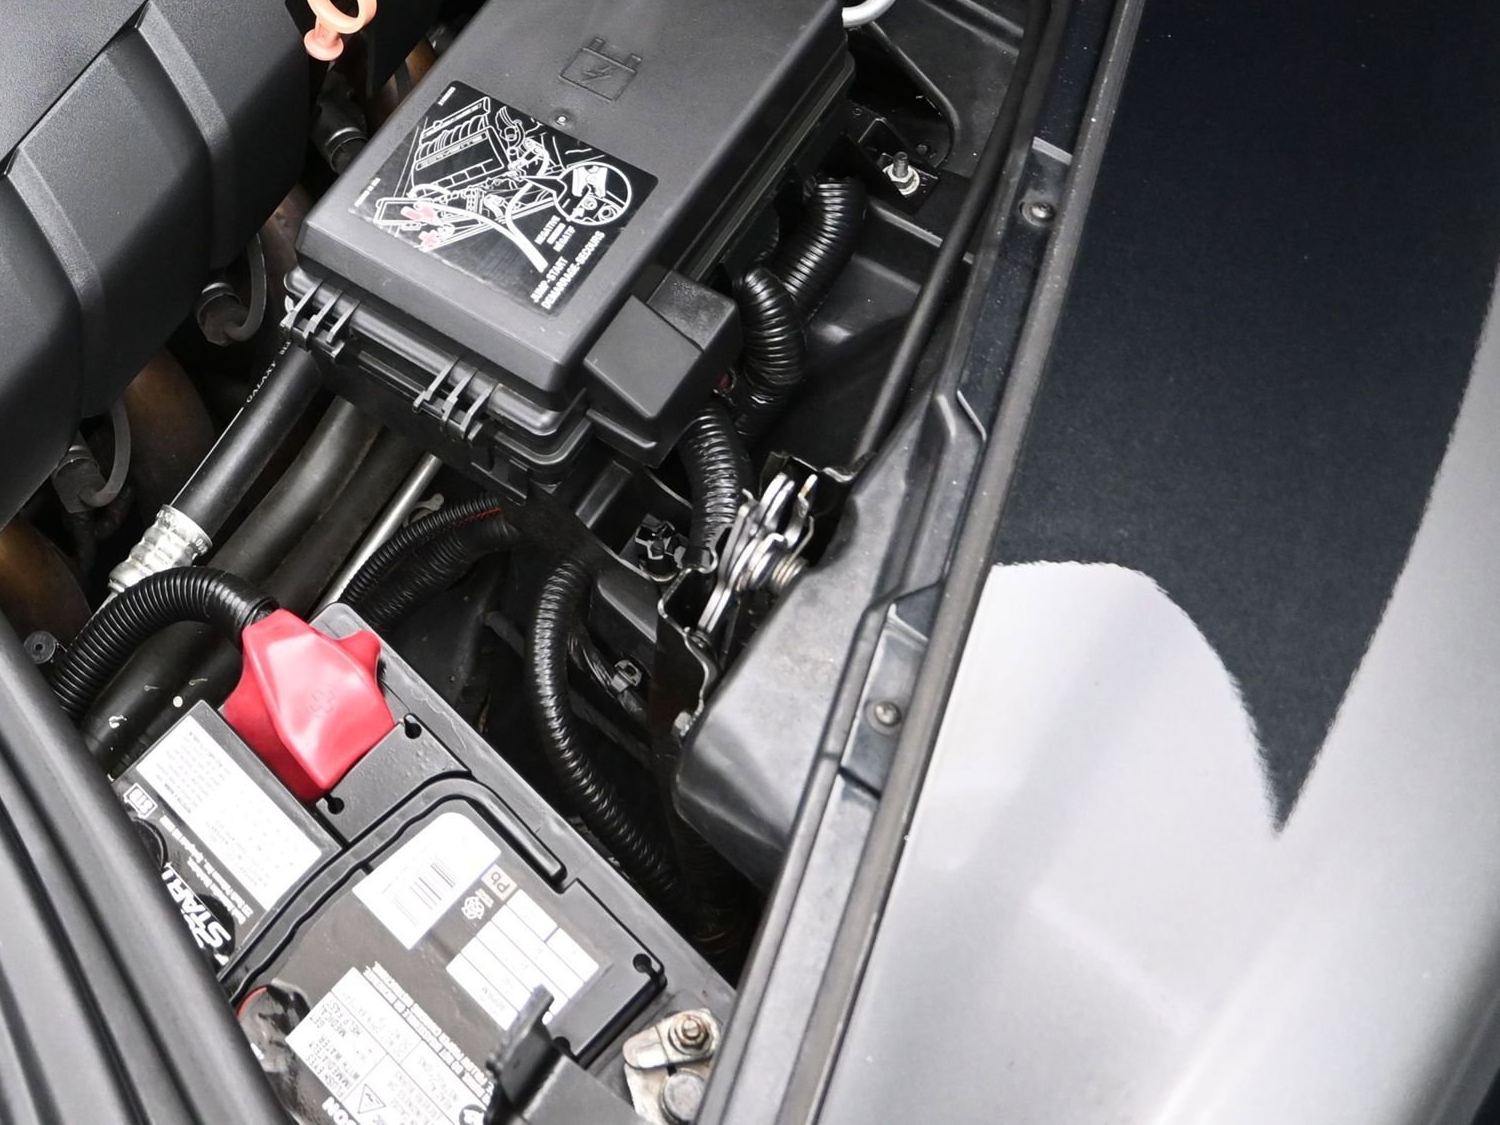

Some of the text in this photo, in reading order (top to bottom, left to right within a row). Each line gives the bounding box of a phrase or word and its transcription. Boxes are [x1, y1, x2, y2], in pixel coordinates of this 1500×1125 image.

[533, 213, 560, 245] NEGATIVE
[528, 255, 568, 303] JUMP-START
[487, 870, 510, 894] Pb
